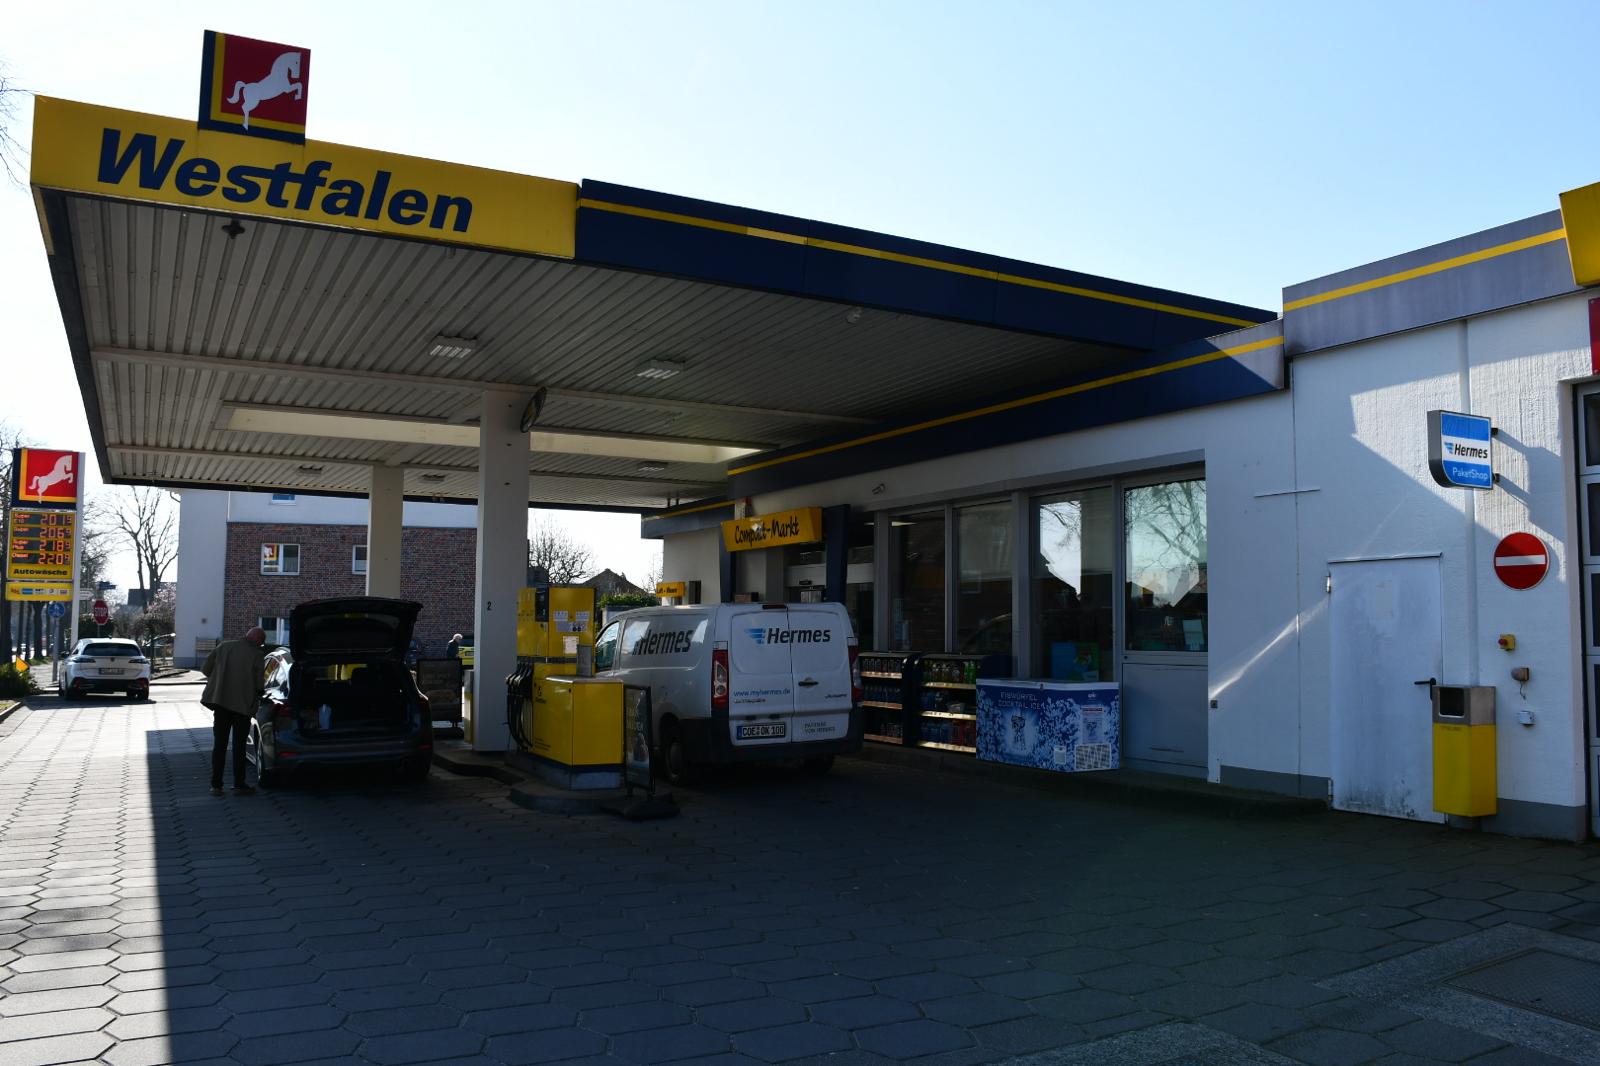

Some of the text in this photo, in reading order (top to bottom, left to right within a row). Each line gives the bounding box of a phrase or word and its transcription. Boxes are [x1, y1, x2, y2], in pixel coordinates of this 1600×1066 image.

[98, 128, 473, 232] Westfalen
[1454, 443, 1488, 459] Hermes
[1453, 467, 1489, 480] PaketShop
[487, 600, 492, 611] 2
[638, 629, 693, 655] Hermes
[767, 627, 831, 644] Hermes
